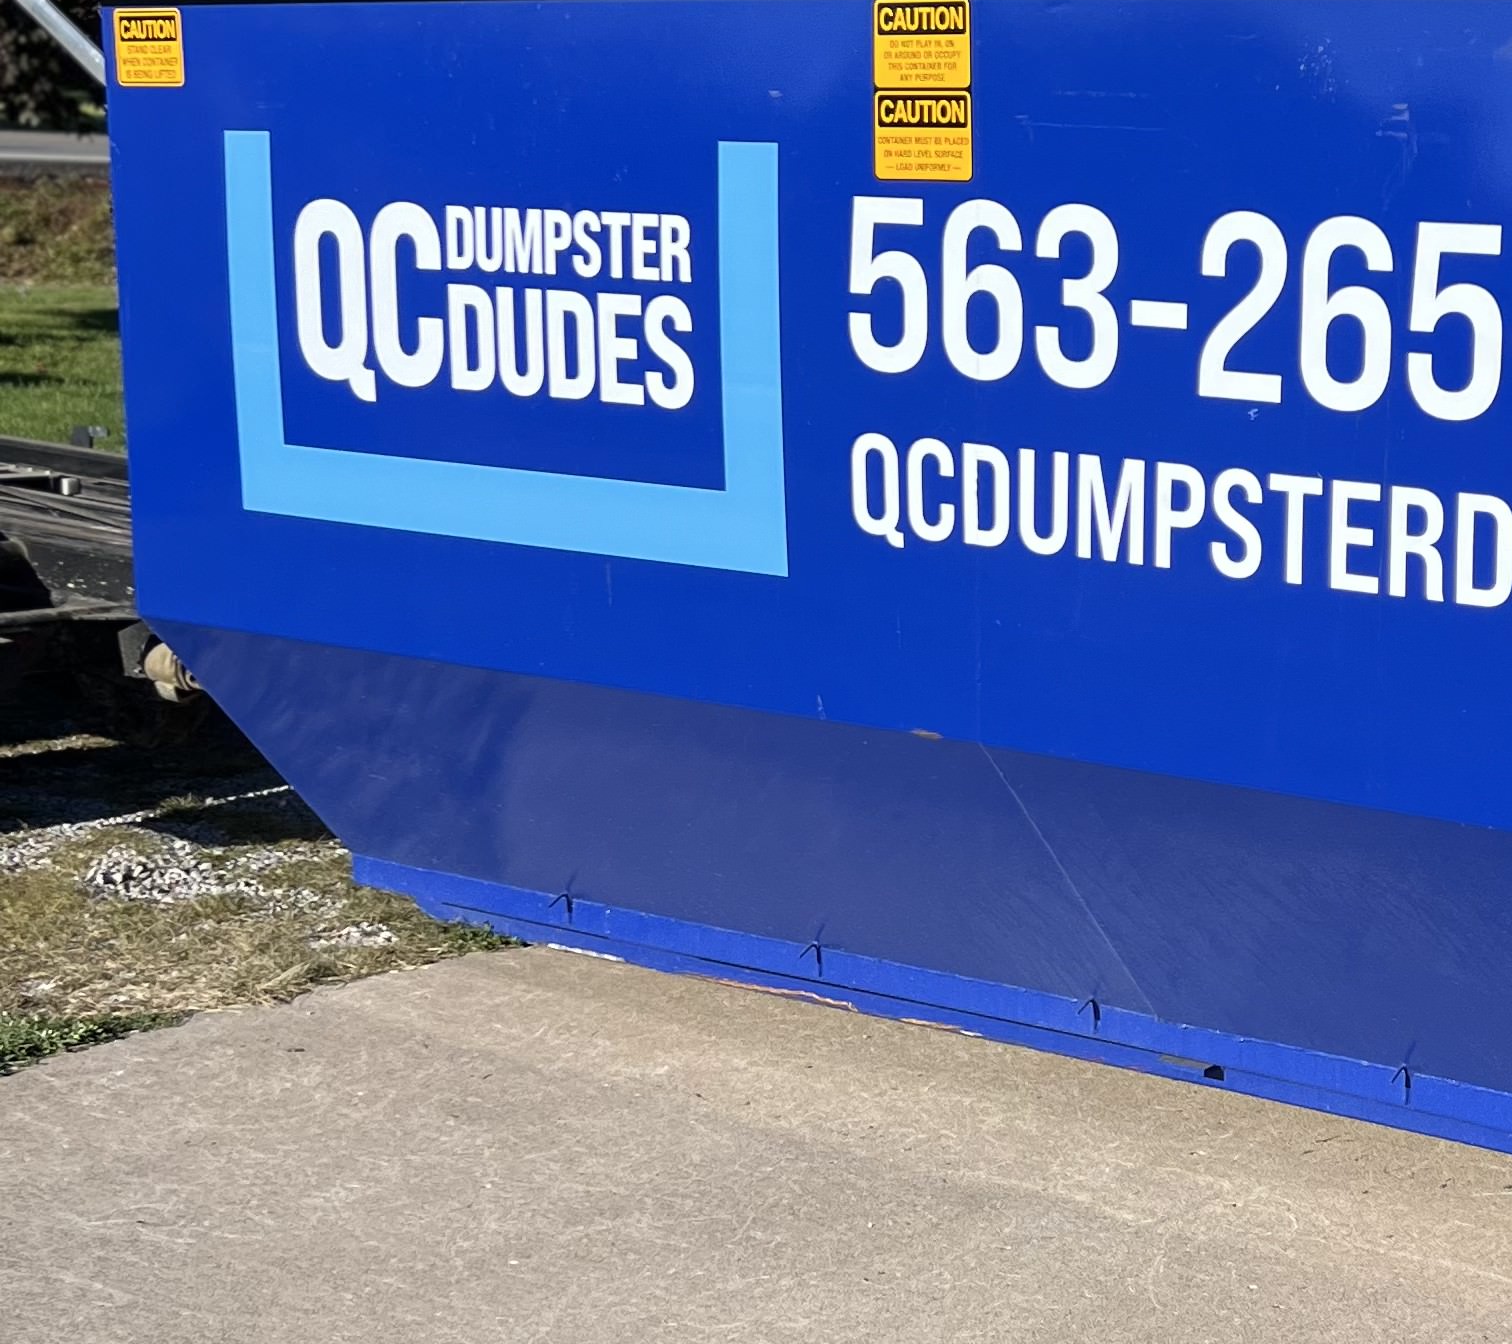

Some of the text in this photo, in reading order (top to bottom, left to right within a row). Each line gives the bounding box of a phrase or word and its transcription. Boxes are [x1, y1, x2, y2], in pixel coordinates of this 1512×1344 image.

[120, 19, 177, 40] CAUTION
[880, 6, 964, 31] CAUTION
[880, 99, 965, 124] CAUTION
[444, 204, 692, 283] DUMPSTER
[293, 198, 444, 403] QC
[446, 283, 694, 410] DUDES
